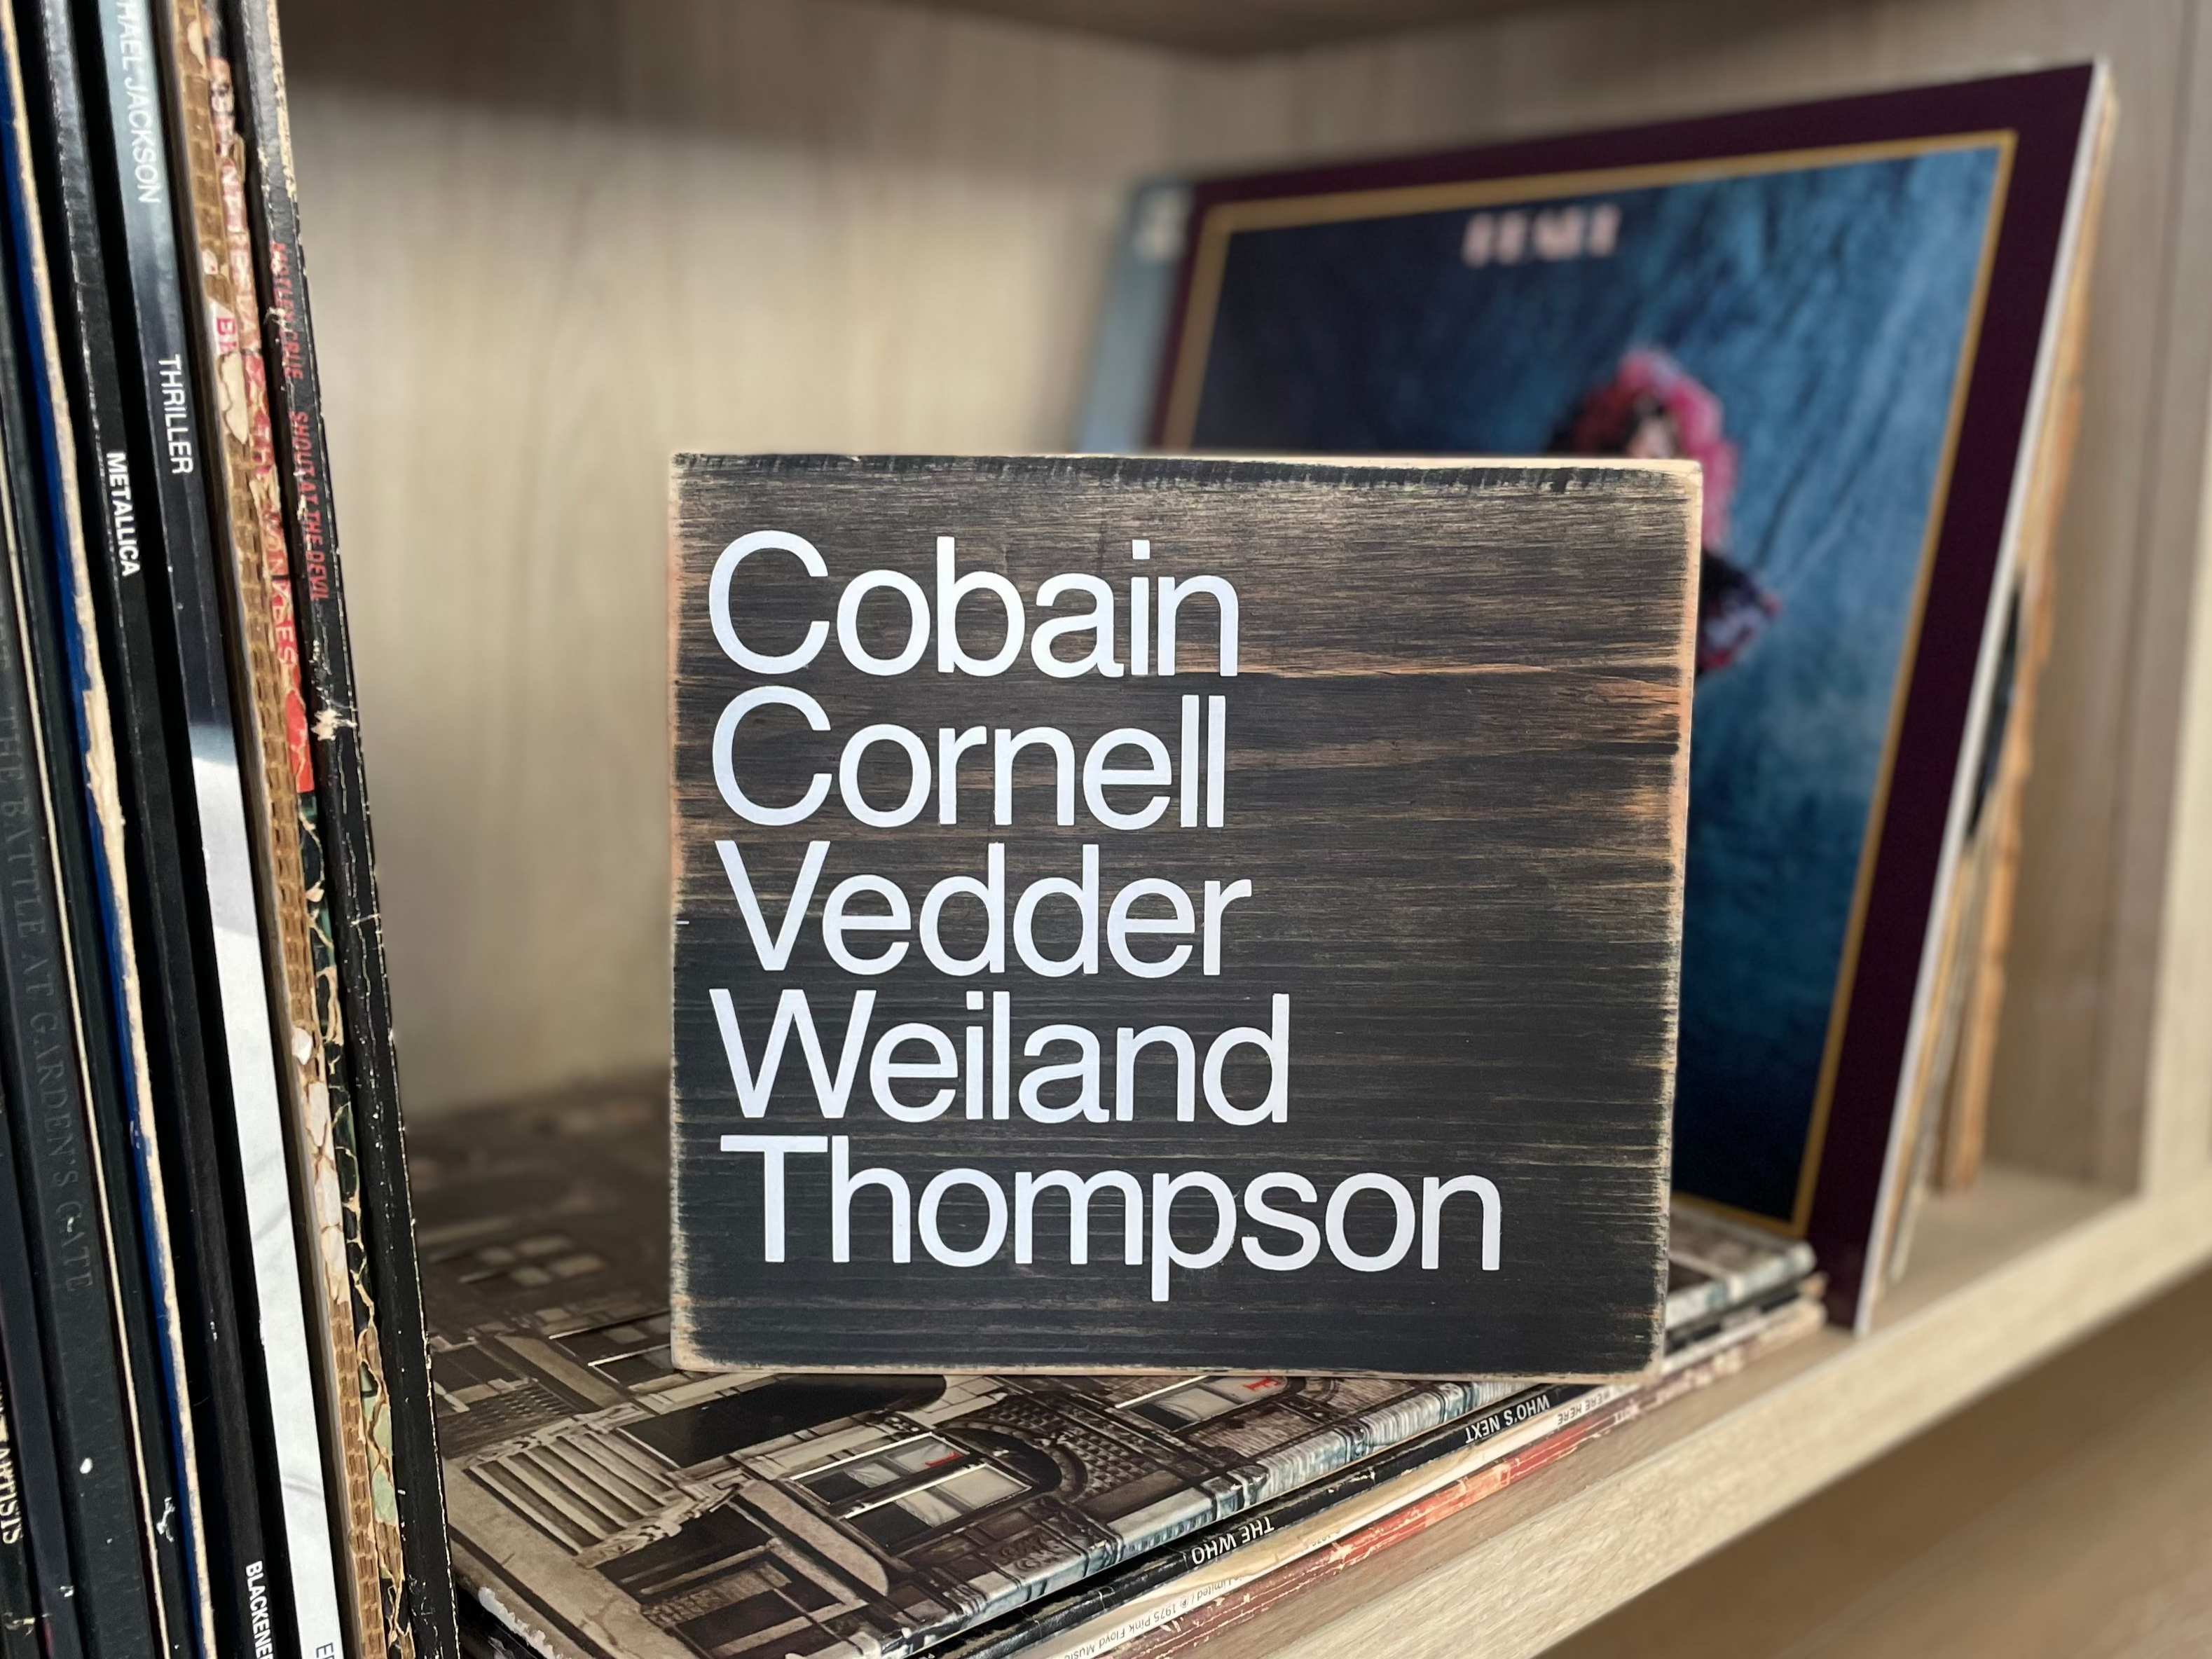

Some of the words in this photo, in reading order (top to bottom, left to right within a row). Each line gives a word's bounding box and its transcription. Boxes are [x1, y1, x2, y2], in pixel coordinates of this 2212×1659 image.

[116, 0, 144, 71] HAEL
[124, 77, 161, 203] JACKSON
[158, 354, 193, 474] THRILLER
[289, 410, 316, 477] SHOUT
[107, 452, 140, 576] METALLICA
[299, 481, 320, 505] AT
[302, 511, 324, 545] THE
[305, 551, 329, 601] DEVIL
[708, 529, 1239, 678] Cobain
[0, 707, 27, 784] THE
[712, 685, 1226, 830] Cornell
[2, 797, 46, 938] BATTLE
[715, 841, 1253, 977] Vedder
[20, 954, 54, 996] AT
[708, 989, 1289, 1124] Weiland
[29, 1012, 80, 1188] GARDEN'S
[55, 1201, 93, 1292] GATE
[720, 1134, 1502, 1302] Thompson
[1465, 1414, 1501, 1444] NEXT
[1505, 1394, 1551, 1426] WHO'S
[1557, 1404, 1583, 1426] HERE
[1192, 1533, 1237, 1564] WHO
[1242, 1516, 1275, 1544] THE
[1099, 1632, 1126, 1649] Floyd
[1129, 1618, 1151, 1634] Pink
[1154, 1604, 1177, 1621] 1975
